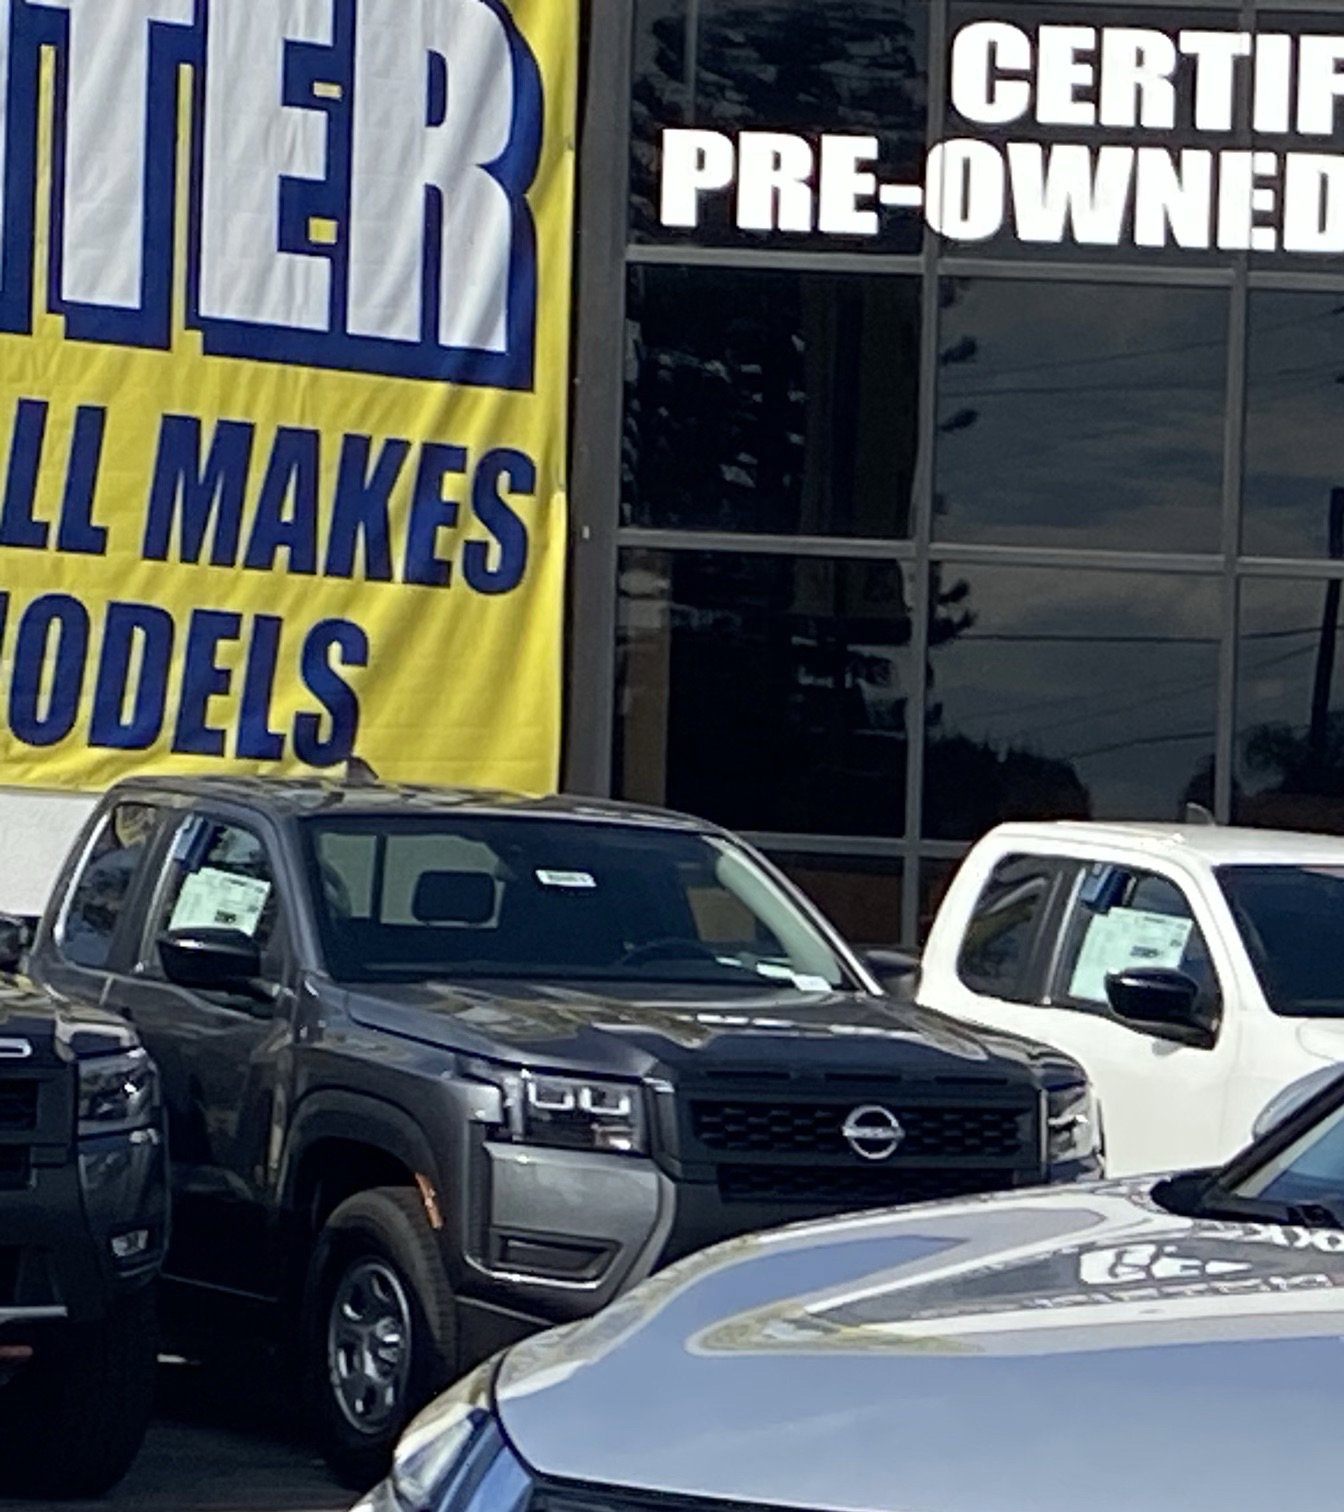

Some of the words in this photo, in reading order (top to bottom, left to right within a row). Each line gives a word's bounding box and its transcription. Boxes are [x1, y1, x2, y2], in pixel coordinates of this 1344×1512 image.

[0, 0, 540, 392] TER
[142, 414, 538, 597] MAKES
[0, 590, 369, 768] ODELS
